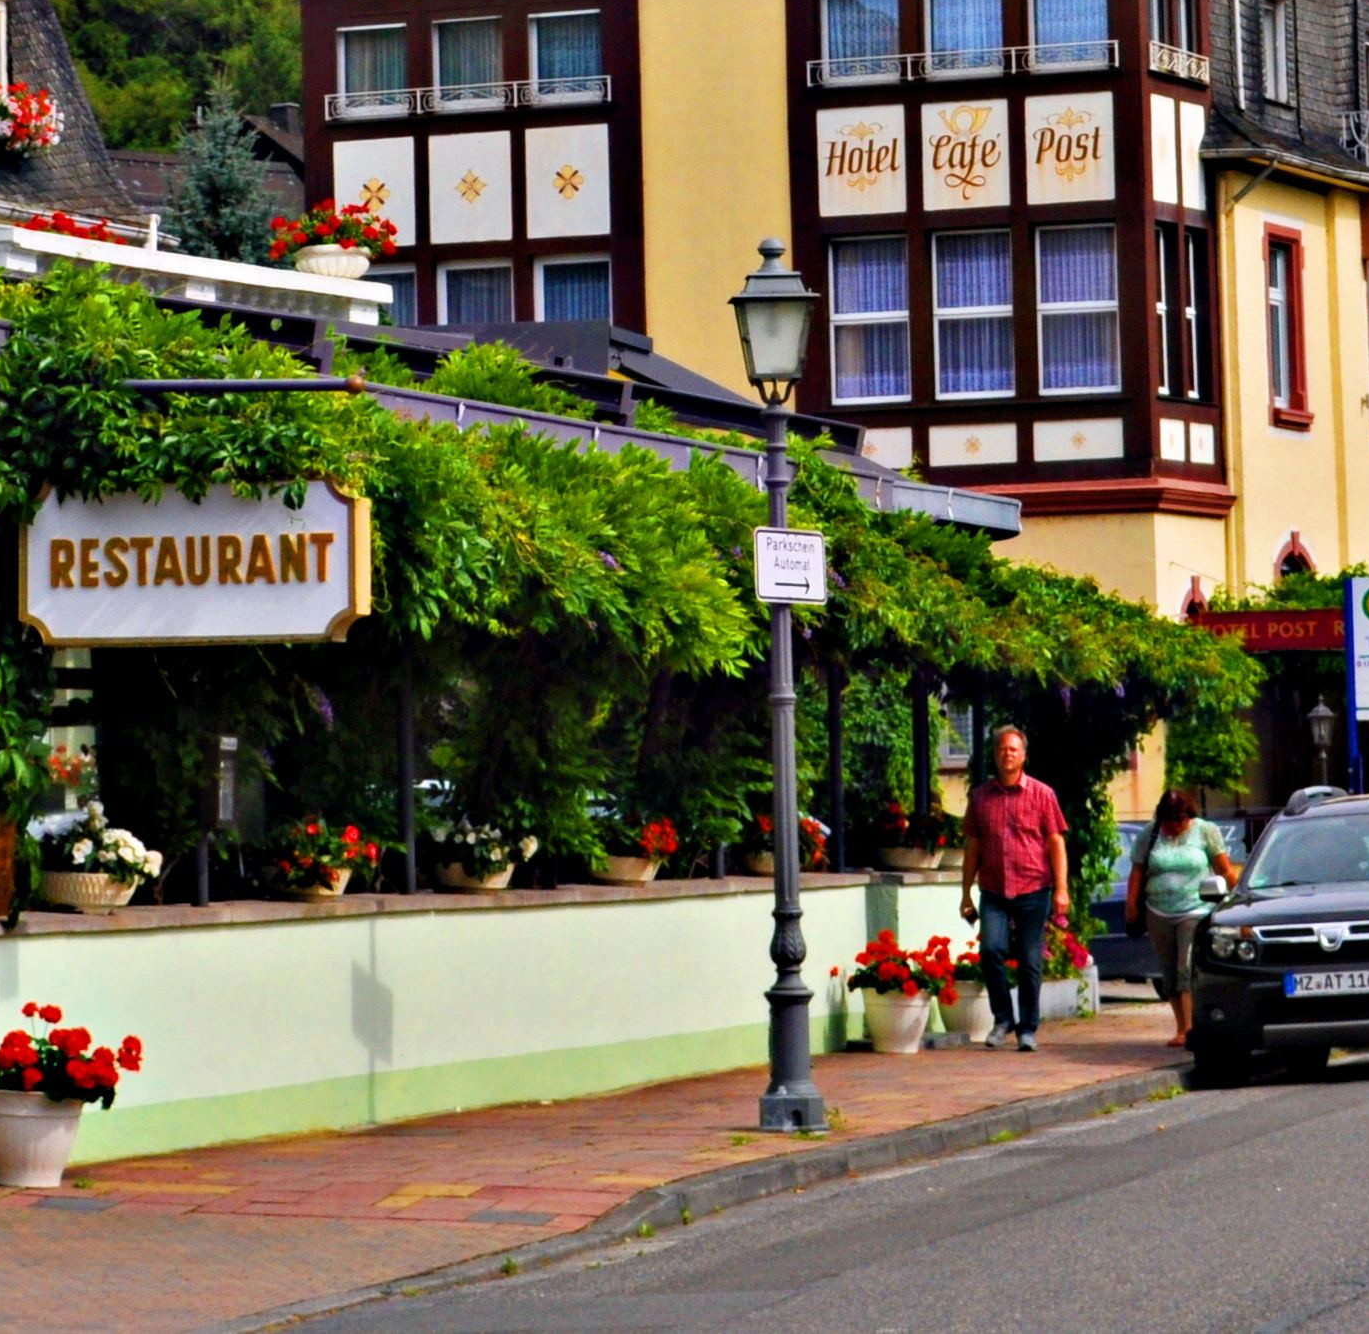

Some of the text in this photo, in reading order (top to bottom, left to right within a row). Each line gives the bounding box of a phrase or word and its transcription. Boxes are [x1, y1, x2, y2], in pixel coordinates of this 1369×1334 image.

[824, 126, 1102, 200] Hotel Café Post
[49, 532, 335, 589] RESTAURANT
[773, 556, 811, 571] Automat
[1267, 620, 1318, 639] POST
[1294, 975, 1314, 991] MZ
[1324, 973, 1344, 990] AT
